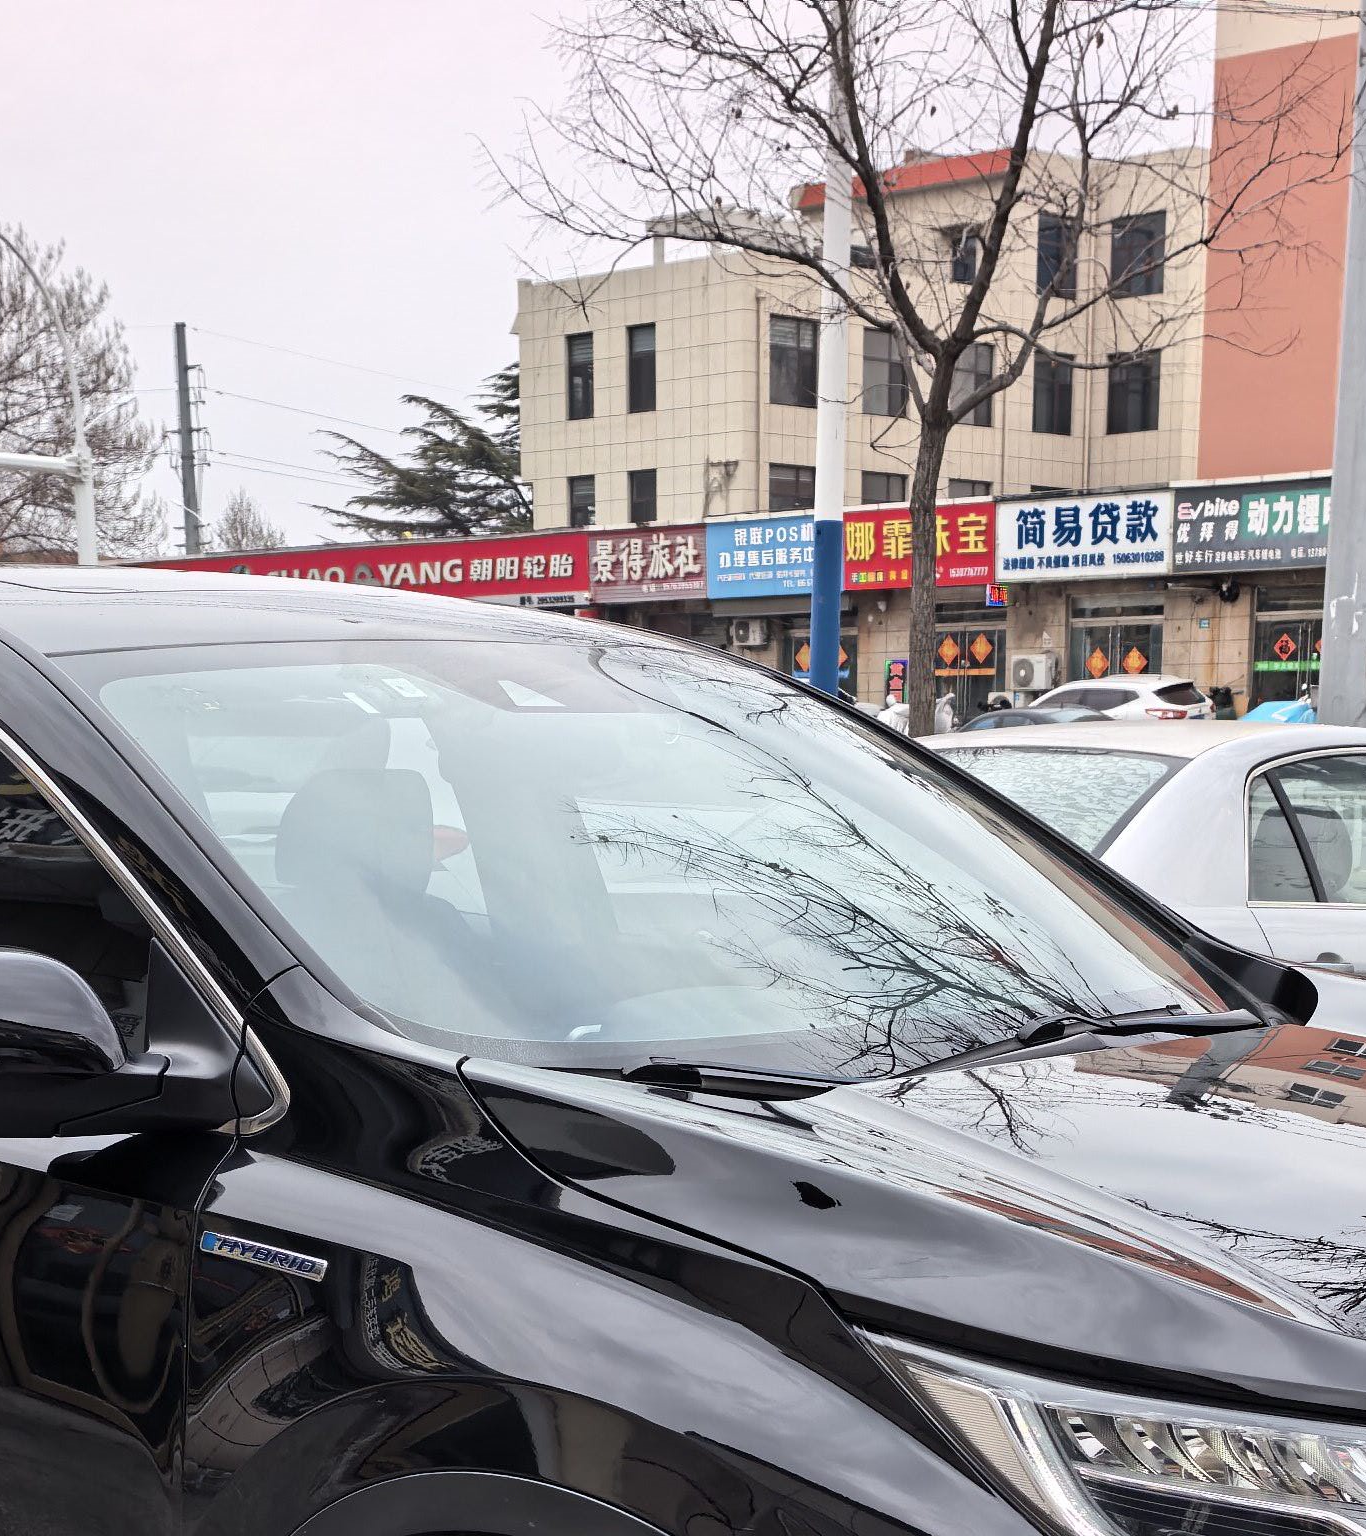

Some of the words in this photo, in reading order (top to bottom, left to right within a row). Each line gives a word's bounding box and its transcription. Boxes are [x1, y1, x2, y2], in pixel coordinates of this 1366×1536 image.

[1016, 499, 1159, 550] 简易贷款
[377, 559, 463, 586] YANG
[469, 554, 574, 582] 朝阳轮胎
[592, 533, 702, 582] 景得旅社
[217, 1238, 317, 1274] HYBRID
